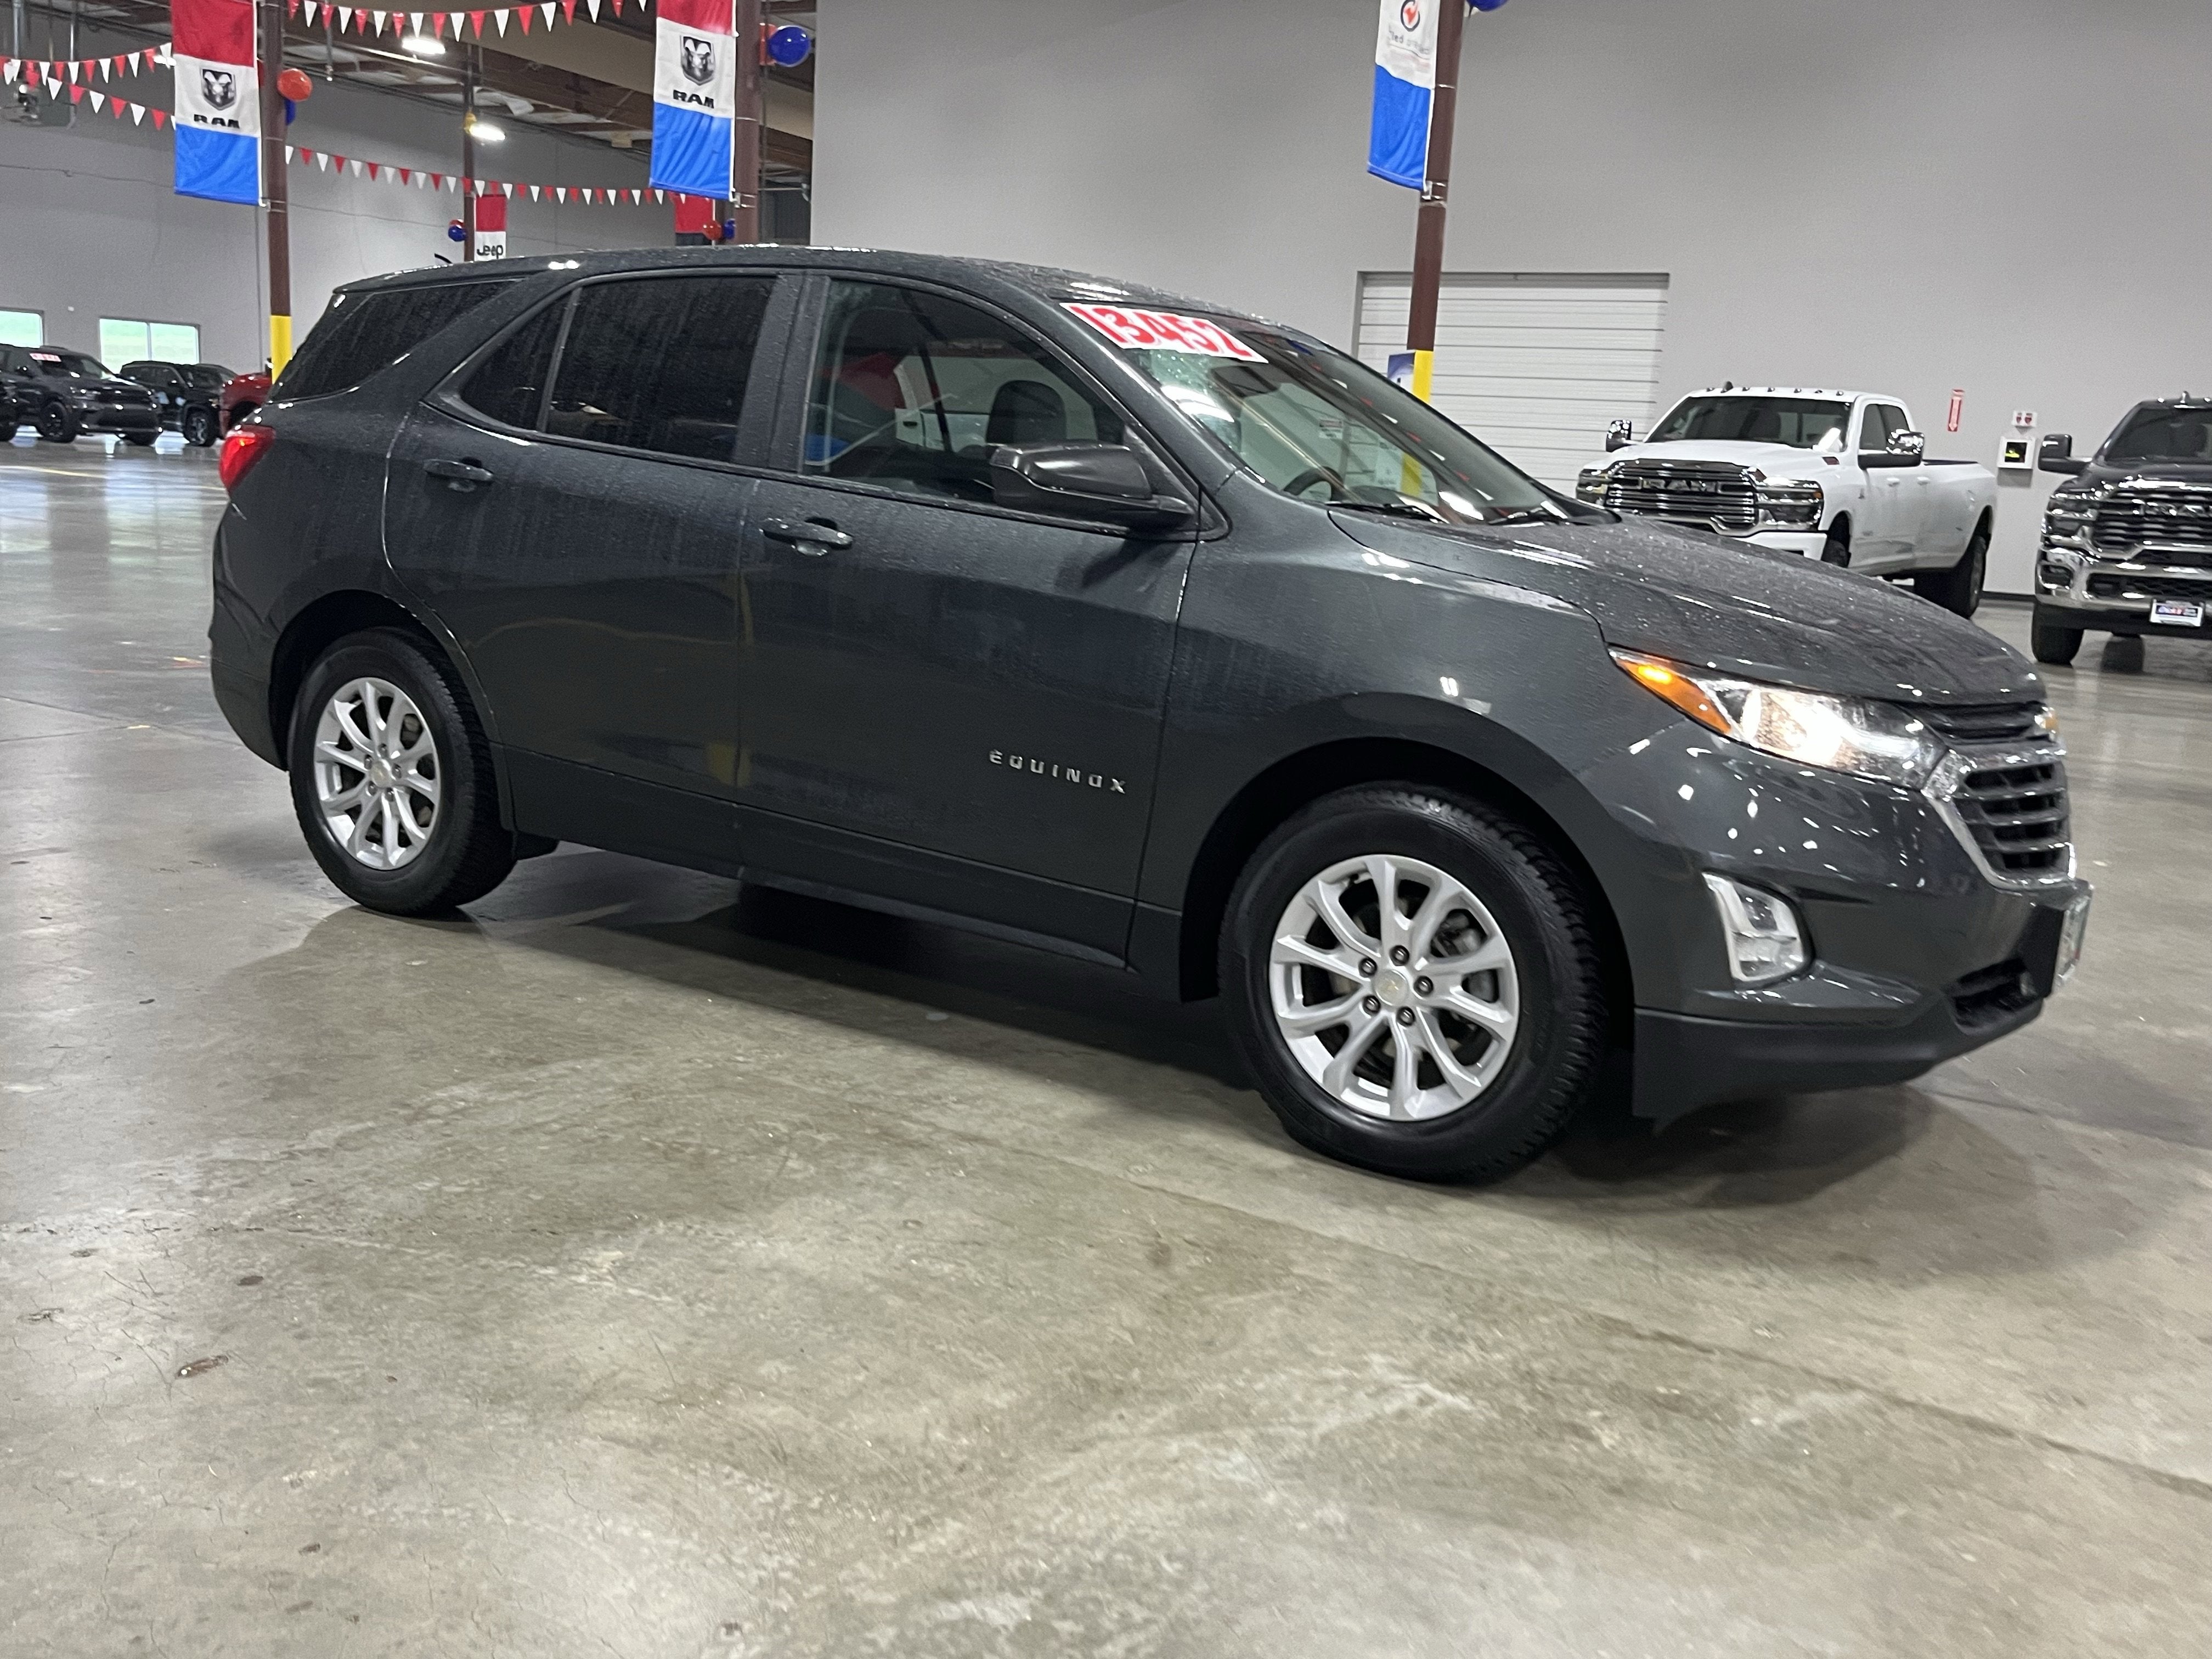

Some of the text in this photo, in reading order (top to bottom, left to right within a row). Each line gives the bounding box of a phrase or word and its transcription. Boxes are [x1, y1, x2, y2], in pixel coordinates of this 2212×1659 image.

[673, 89, 714, 109] RAM
[194, 114, 240, 129] RAM
[477, 245, 504, 259] Jeep
[1070, 306, 1253, 357] 13452
[1642, 479, 1717, 494] RAM
[989, 749, 1126, 794] EQUINOX
